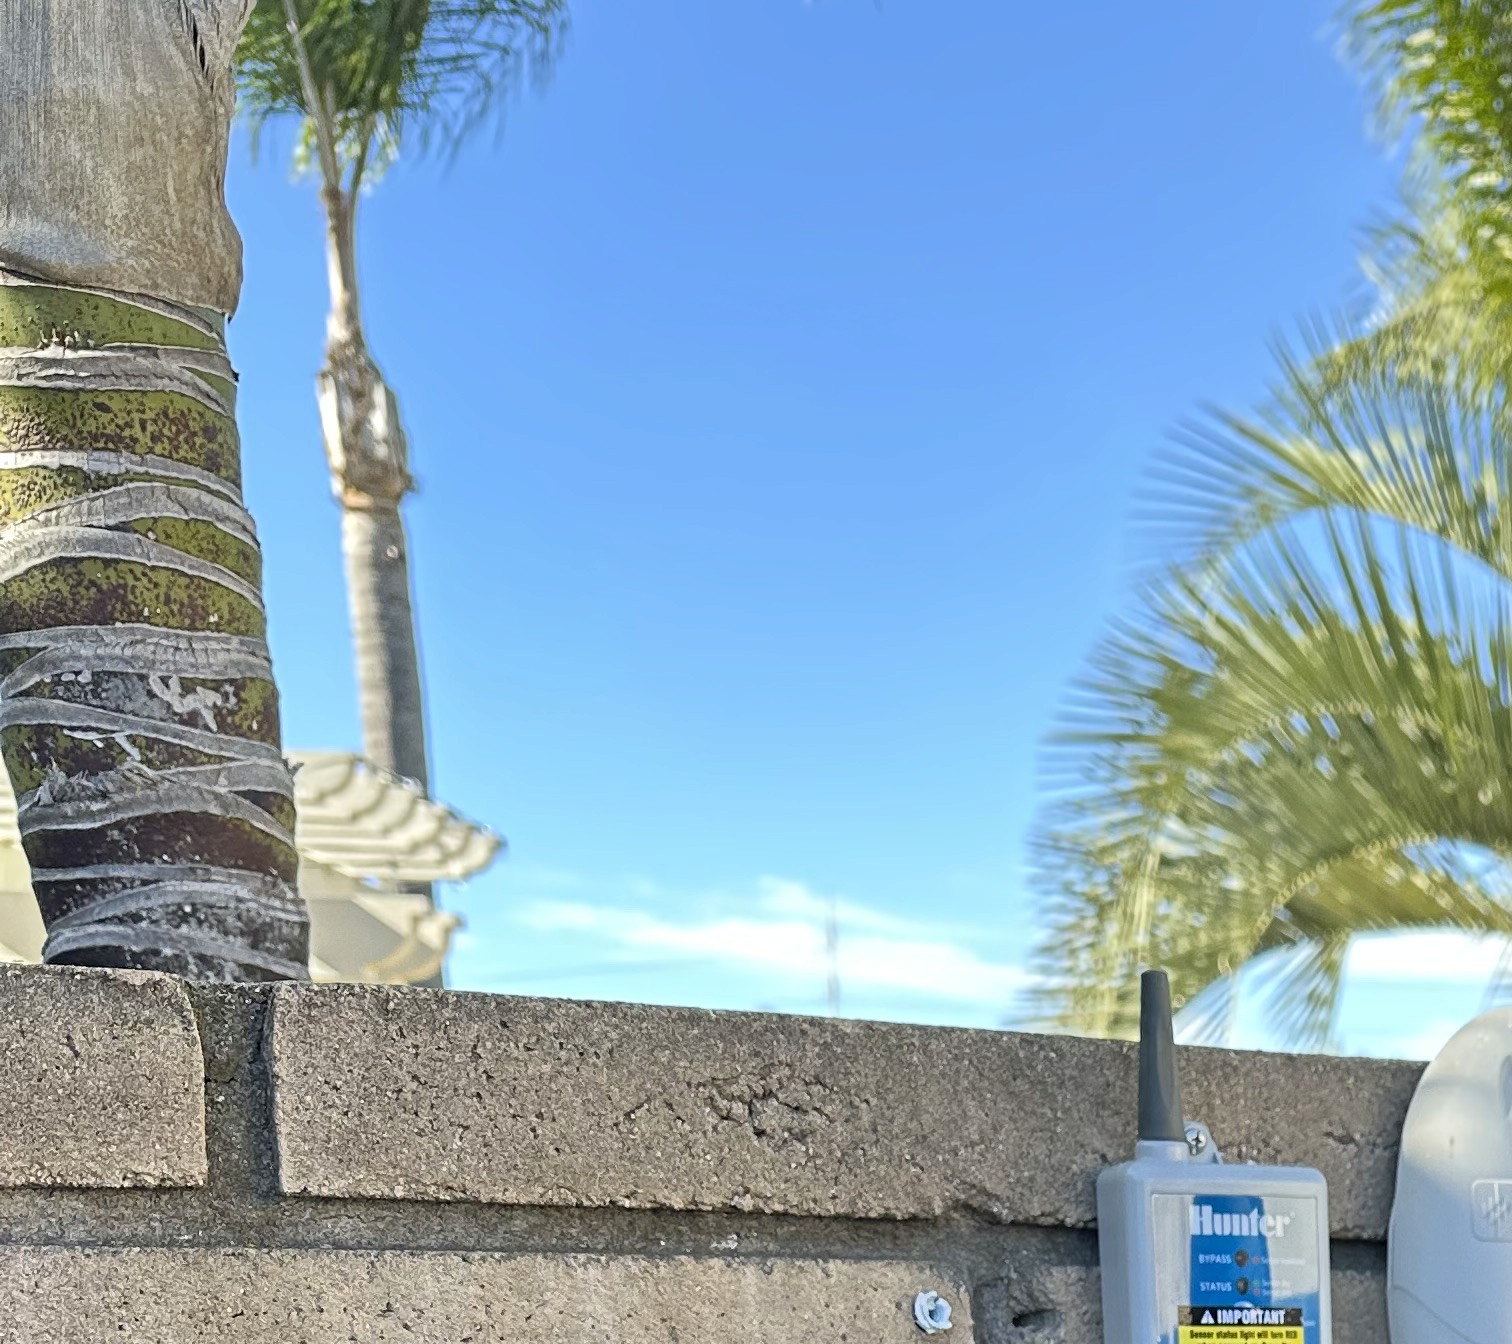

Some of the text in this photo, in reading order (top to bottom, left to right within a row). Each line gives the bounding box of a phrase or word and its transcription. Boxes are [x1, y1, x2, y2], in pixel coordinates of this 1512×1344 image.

[1190, 1204, 1291, 1237] Hunter
[1199, 1254, 1232, 1264] BYPASS
[1200, 1282, 1232, 1291] STATUS
[1217, 1309, 1285, 1324] IMPORTANT
